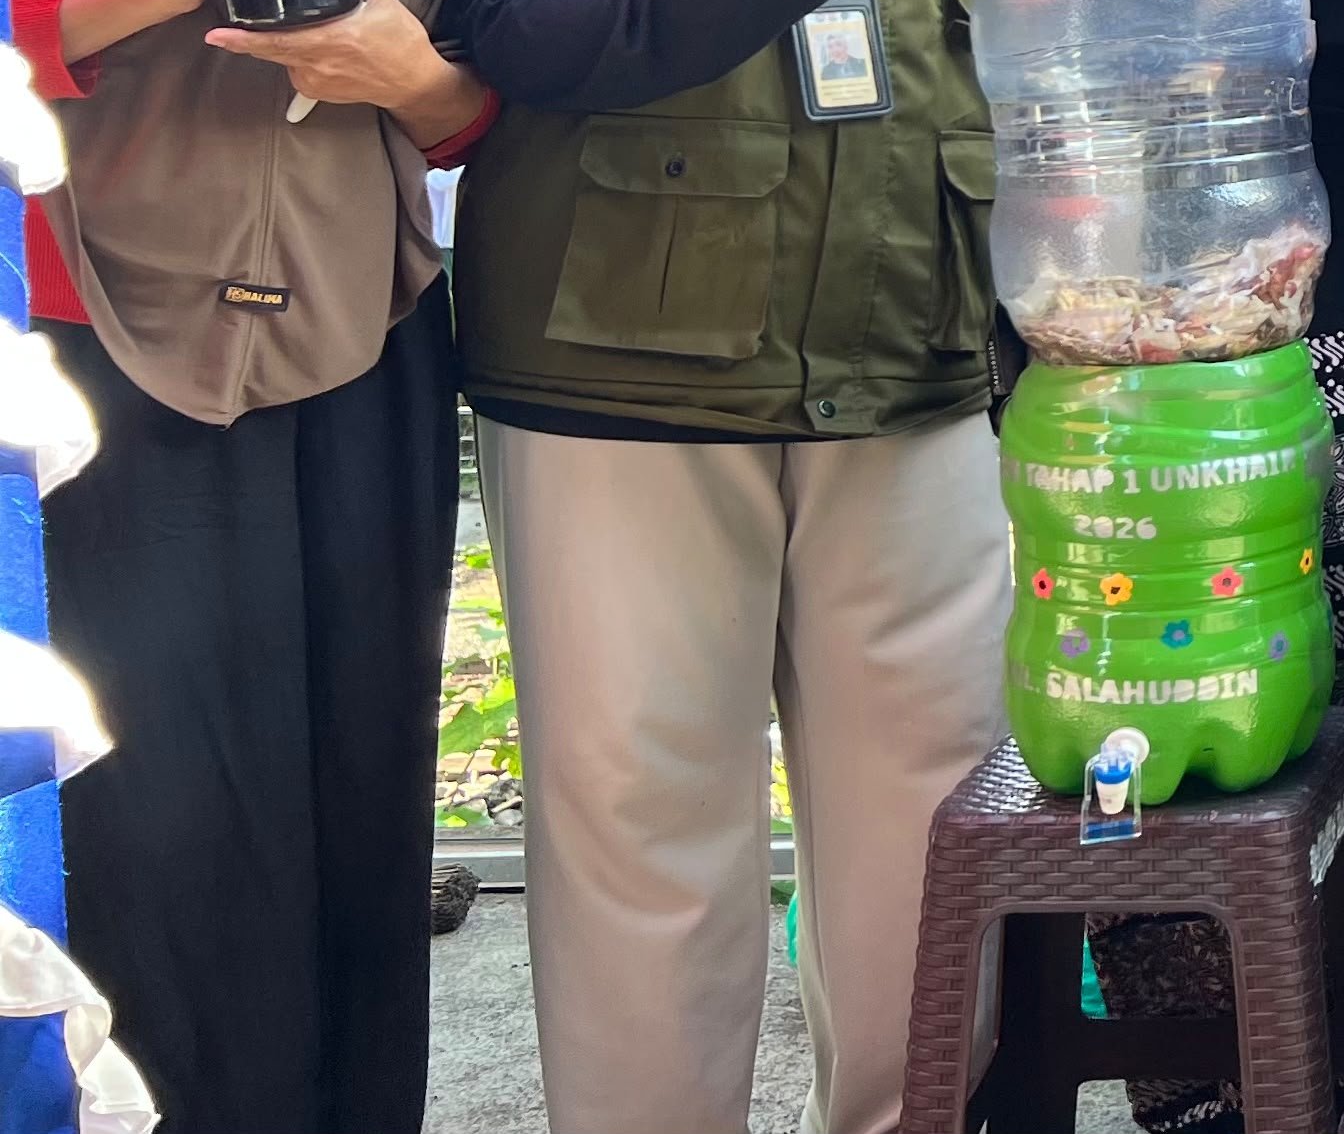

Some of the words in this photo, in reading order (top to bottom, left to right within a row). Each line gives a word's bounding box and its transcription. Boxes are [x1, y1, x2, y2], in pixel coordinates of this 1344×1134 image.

[1026, 462, 1115, 494] TAHAP
[1123, 469, 1141, 494] 1
[1073, 513, 1158, 540] 2026
[1046, 668, 1259, 705] SALAHUDDIN
